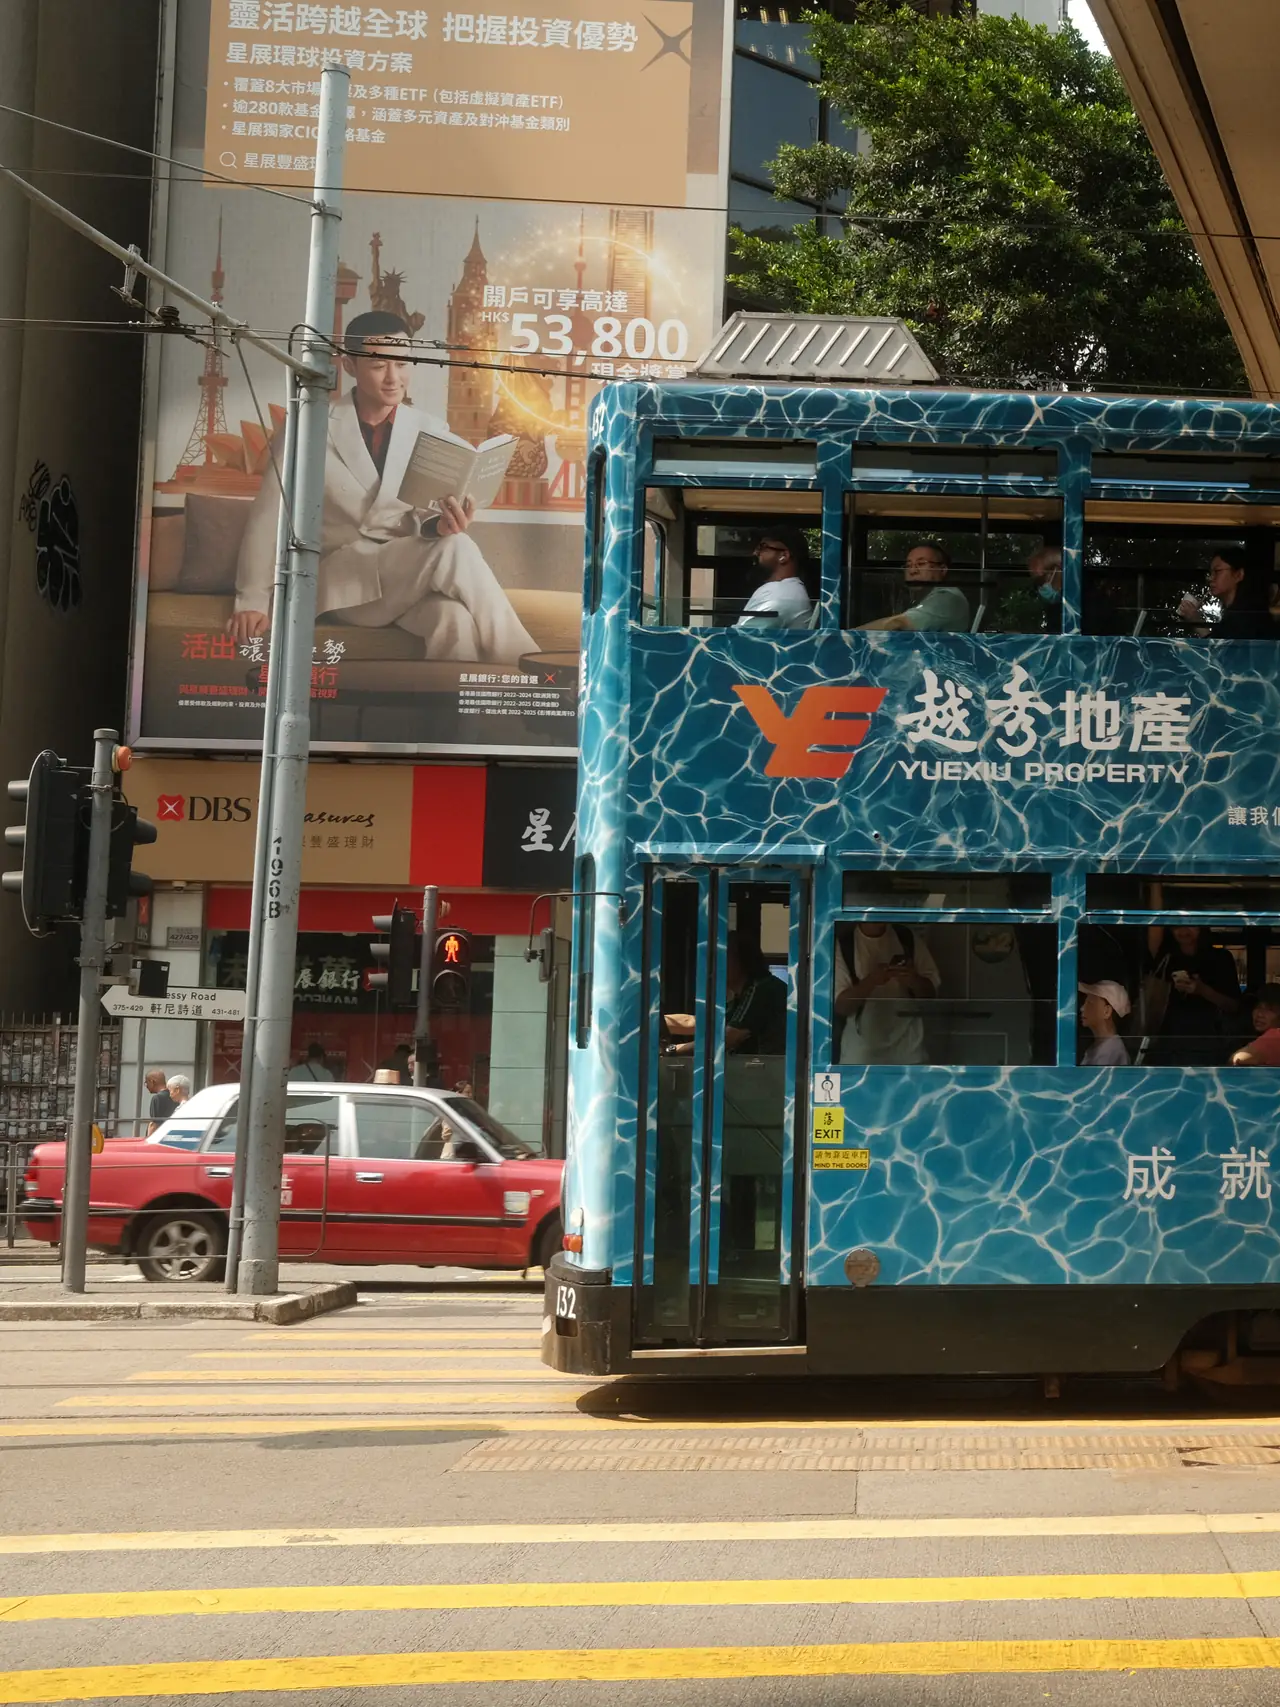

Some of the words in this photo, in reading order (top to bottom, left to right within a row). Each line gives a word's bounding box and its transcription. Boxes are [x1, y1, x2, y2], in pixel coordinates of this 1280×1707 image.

[228, 0, 428, 41] 靈活跨越全球
[442, 11, 639, 52] 把握投資優勢
[226, 42, 413, 74] 星展環球投資方案
[233, 76, 428, 102] 覆蓋8大市場及多種ETF
[482, 284, 630, 314] 開戶可享高達
[509, 312, 689, 367] 53,800
[896, 664, 1193, 758] 越秀地產
[897, 761, 1012, 783] YUEXIU
[1024, 762, 1191, 785] PROPERTY
[188, 796, 252, 823] DBS
[303, 811, 376, 828] asures
[520, 807, 577, 852] 星
[112, 1003, 144, 1012] 375-429
[150, 1003, 204, 1017] 軒尼詩道
[165, 992, 187, 1001] essy
[190, 991, 217, 1001] Road
[211, 1008, 240, 1016] 431-481
[815, 1129, 842, 1139] EXIT
[556, 1285, 577, 1320] 132
